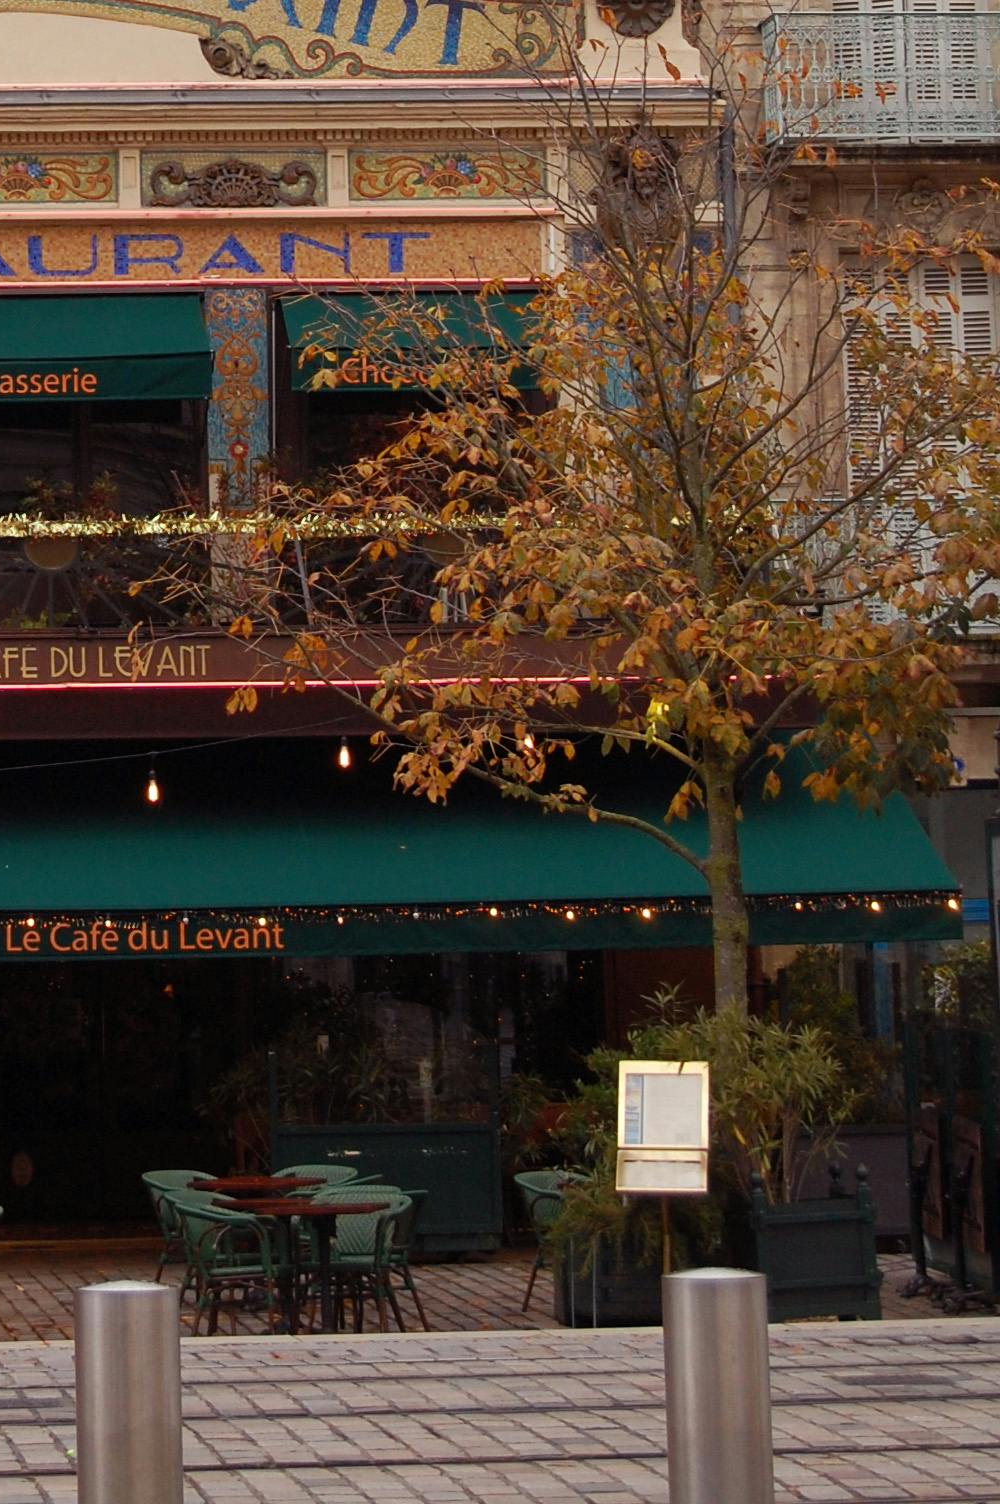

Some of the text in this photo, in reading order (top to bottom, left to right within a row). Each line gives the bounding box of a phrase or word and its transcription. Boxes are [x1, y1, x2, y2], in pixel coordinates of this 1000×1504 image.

[50, 647, 87, 678] DU
[98, 645, 211, 678] LEVANT
[6, 924, 42, 953] Le
[128, 920, 169, 951] du
[180, 922, 285, 950] Levant
